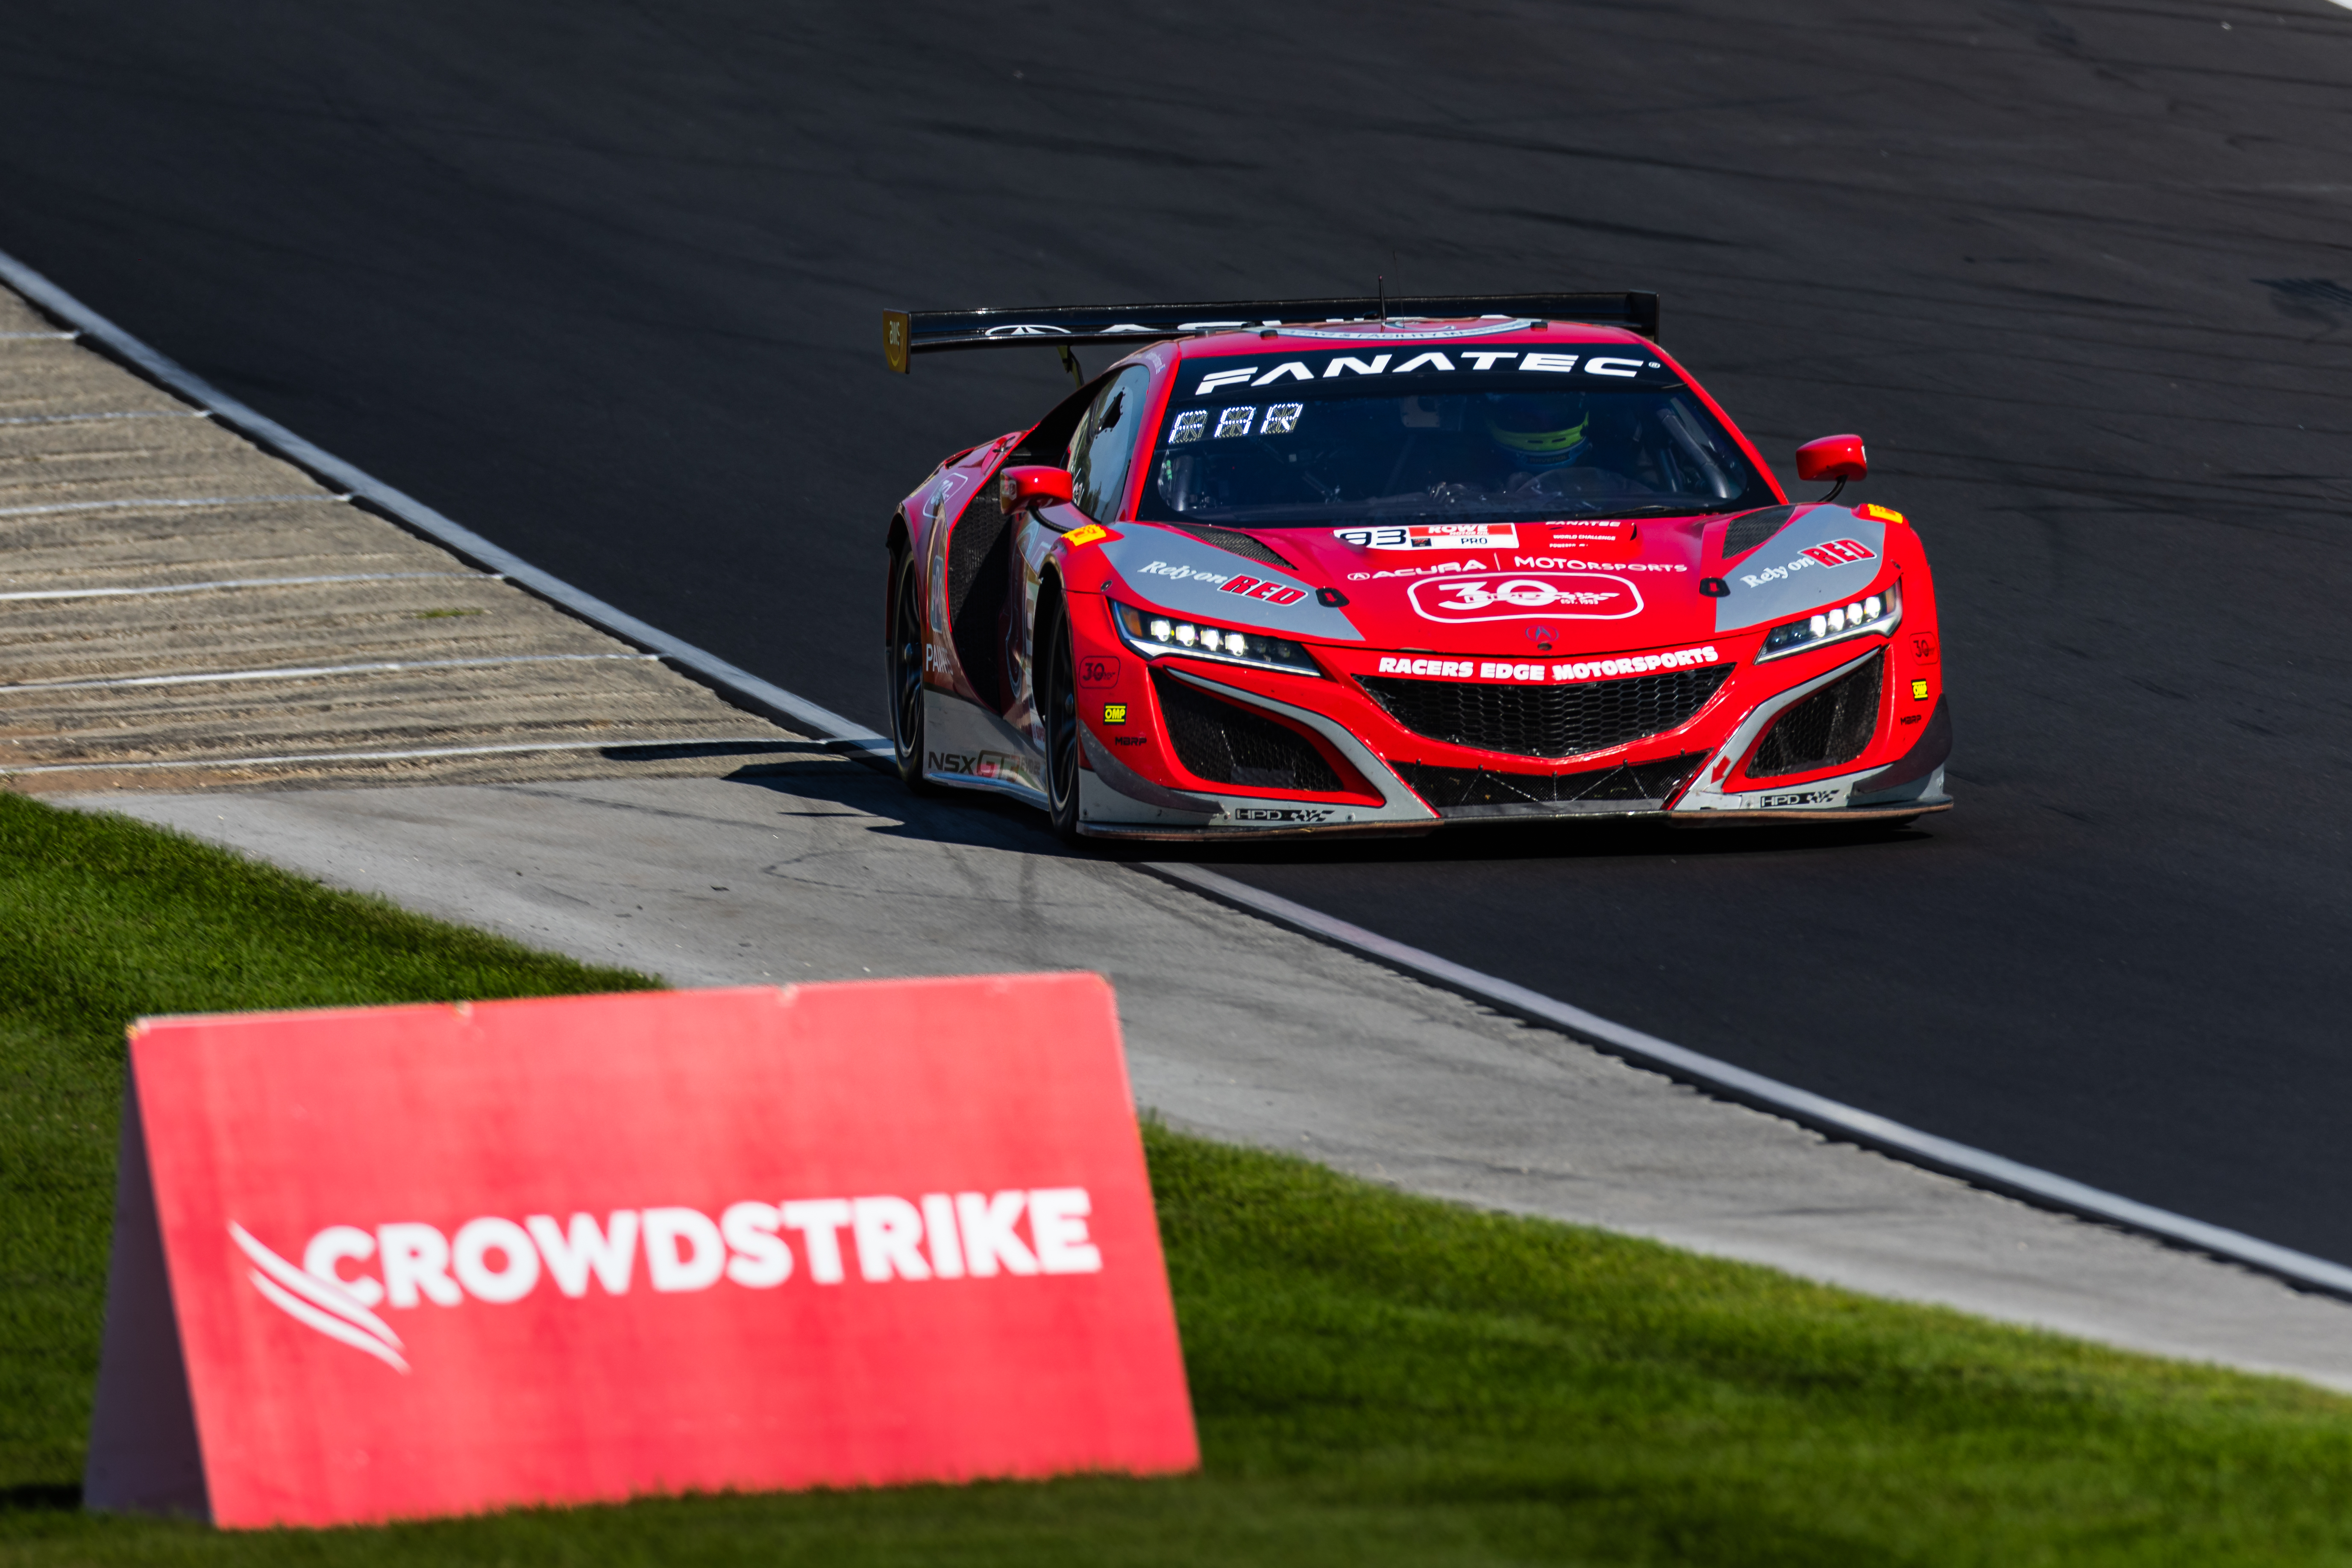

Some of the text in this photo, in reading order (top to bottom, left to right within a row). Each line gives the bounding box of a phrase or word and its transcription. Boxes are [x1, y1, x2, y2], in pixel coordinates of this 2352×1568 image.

[1428, 524, 1489, 534] ROWE
[1371, 556, 1688, 578] ACURA MOTORSPORTS
[1739, 537, 1878, 588] Rely on RED
[1217, 573, 1309, 606] RED
[1438, 579, 1558, 610] 30
[1082, 663, 1105, 681] 30
[1379, 646, 1719, 681] RACERS EDGE MOTORSPORTS
[1105, 708, 1126, 719] OMP
[928, 751, 976, 776] NSX
[1761, 794, 1800, 807] HPD
[1236, 809, 1282, 820] HPD
[301, 1188, 1102, 1308] CROWDSTRIKE
